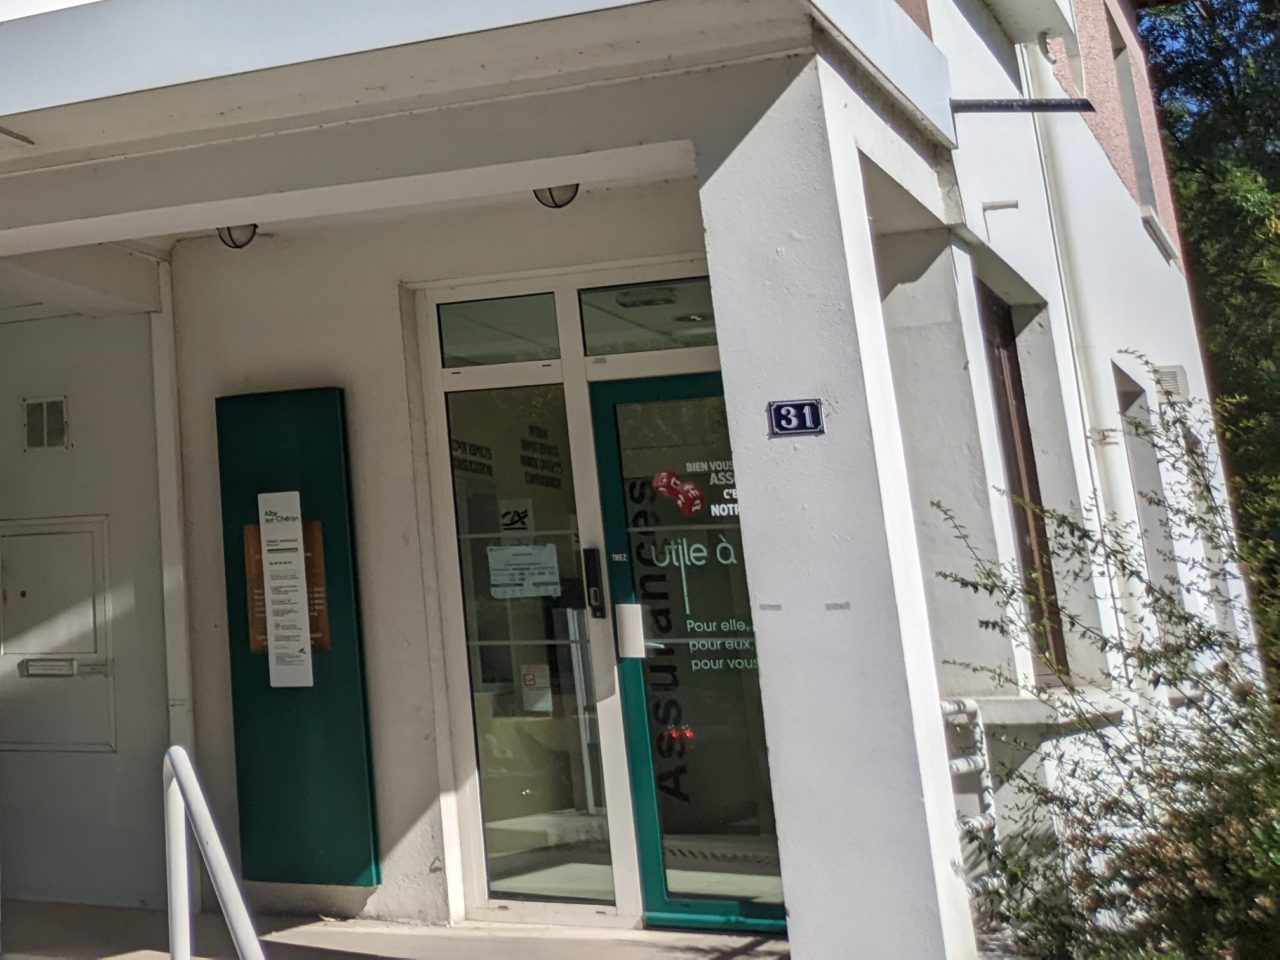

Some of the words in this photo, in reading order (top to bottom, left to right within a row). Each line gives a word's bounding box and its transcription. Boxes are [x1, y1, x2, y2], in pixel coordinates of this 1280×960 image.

[781, 406, 815, 429] 31
[686, 462, 708, 472] BIEN
[710, 472, 735, 485] ASS
[716, 534, 737, 565] à
[686, 620, 717, 632] Pour
[720, 619, 750, 632] elle,
[689, 639, 721, 653] pour
[691, 659, 724, 672] pour
